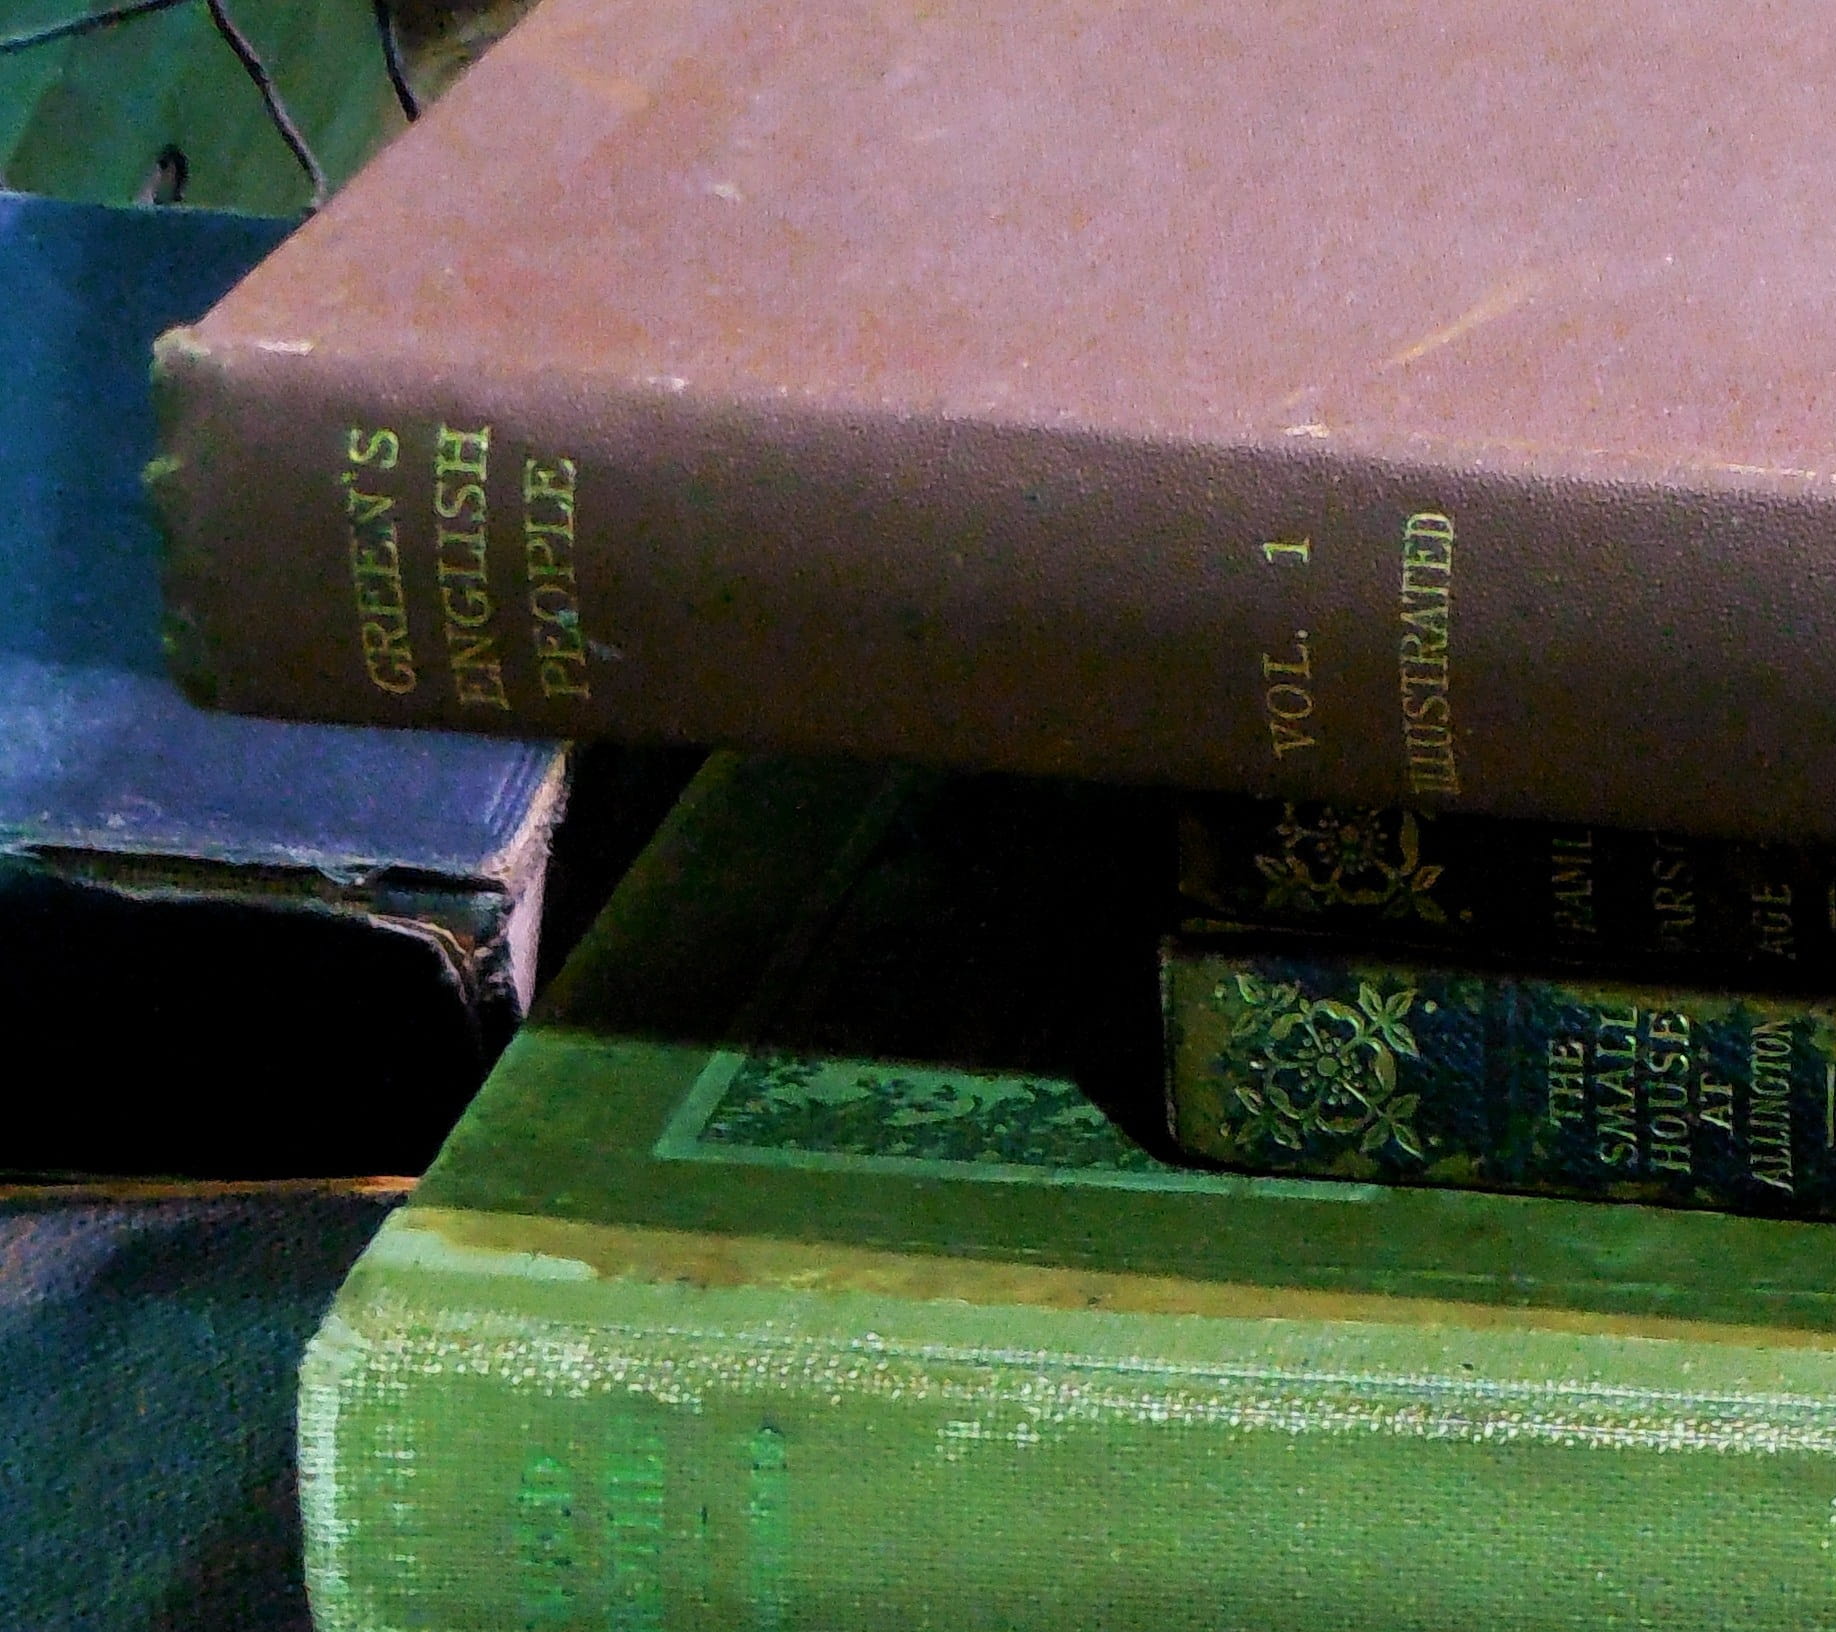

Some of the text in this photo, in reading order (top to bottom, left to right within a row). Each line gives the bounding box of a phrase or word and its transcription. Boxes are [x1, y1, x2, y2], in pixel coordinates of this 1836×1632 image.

[341, 426, 417, 695] GREEN'S
[434, 424, 509, 711] ENGLISH
[524, 457, 589, 700] PEOPLE
[1262, 629, 1316, 760] VOL.
[1401, 512, 1461, 796] ILLUSTRATED
[1548, 1039, 1584, 1127] THE
[1597, 1005, 1639, 1167] SMALL
[1648, 1012, 1692, 1175] HOUSE
[1700, 1070, 1735, 1136] AT
[1748, 1019, 1794, 1193] ALLINGTON
